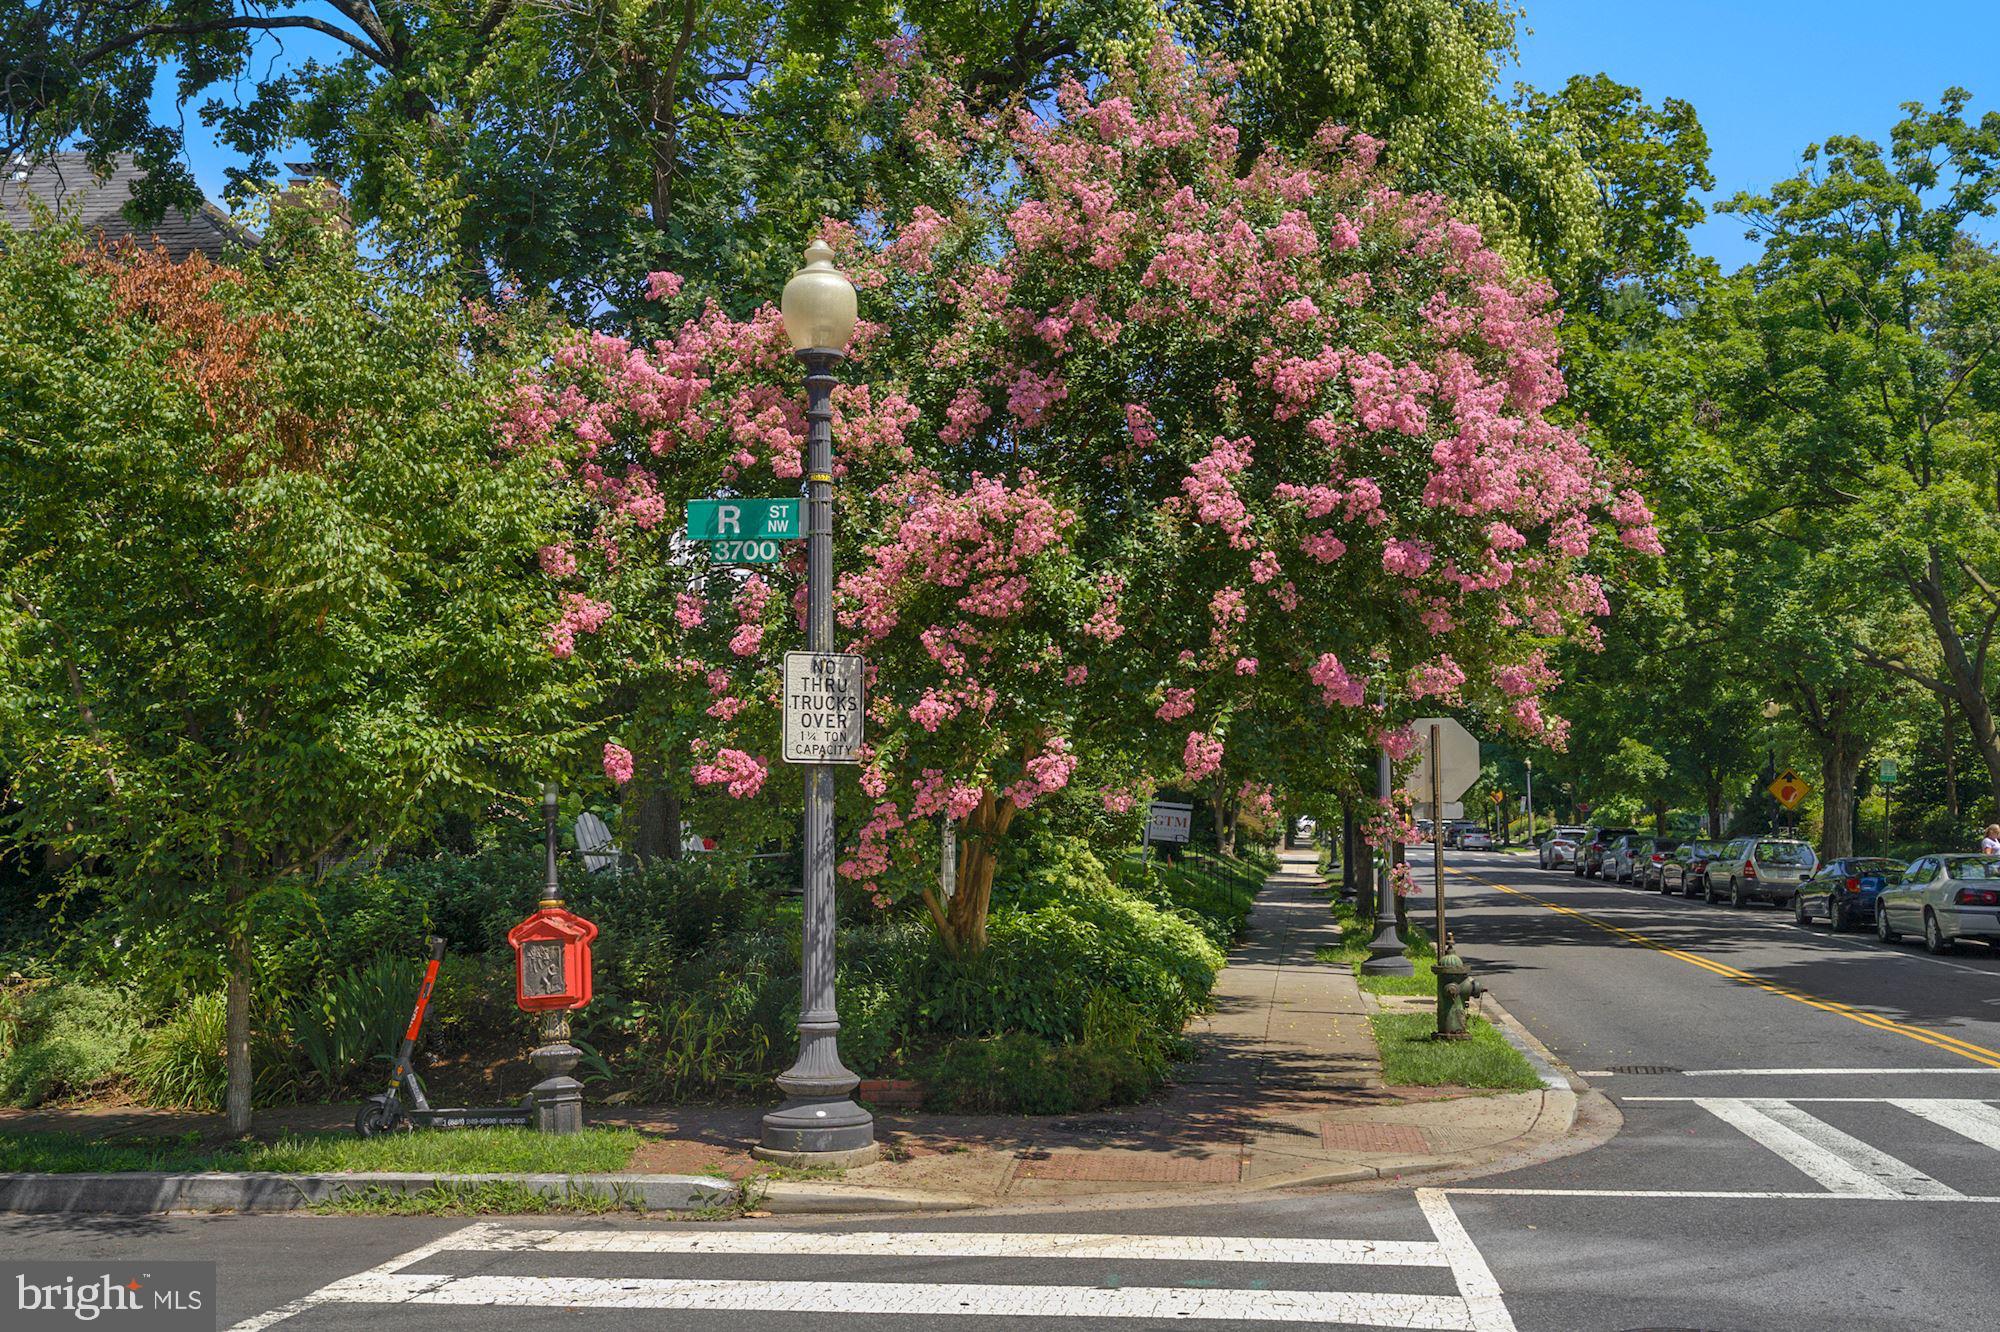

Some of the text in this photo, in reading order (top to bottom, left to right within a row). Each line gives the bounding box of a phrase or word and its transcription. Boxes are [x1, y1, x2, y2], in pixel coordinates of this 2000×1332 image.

[718, 505, 741, 534] R
[769, 505, 790, 519] ST
[767, 520, 789, 533] NW
[714, 540, 776, 561] 3700
[812, 659, 836, 674] NO
[801, 677, 847, 693] THRU
[791, 695, 857, 711] TRUCKS
[801, 713, 847, 728] OVER
[824, 731, 847, 742] TON
[795, 745, 852, 755] CAPACITY
[1153, 815, 1187, 828] GTM
